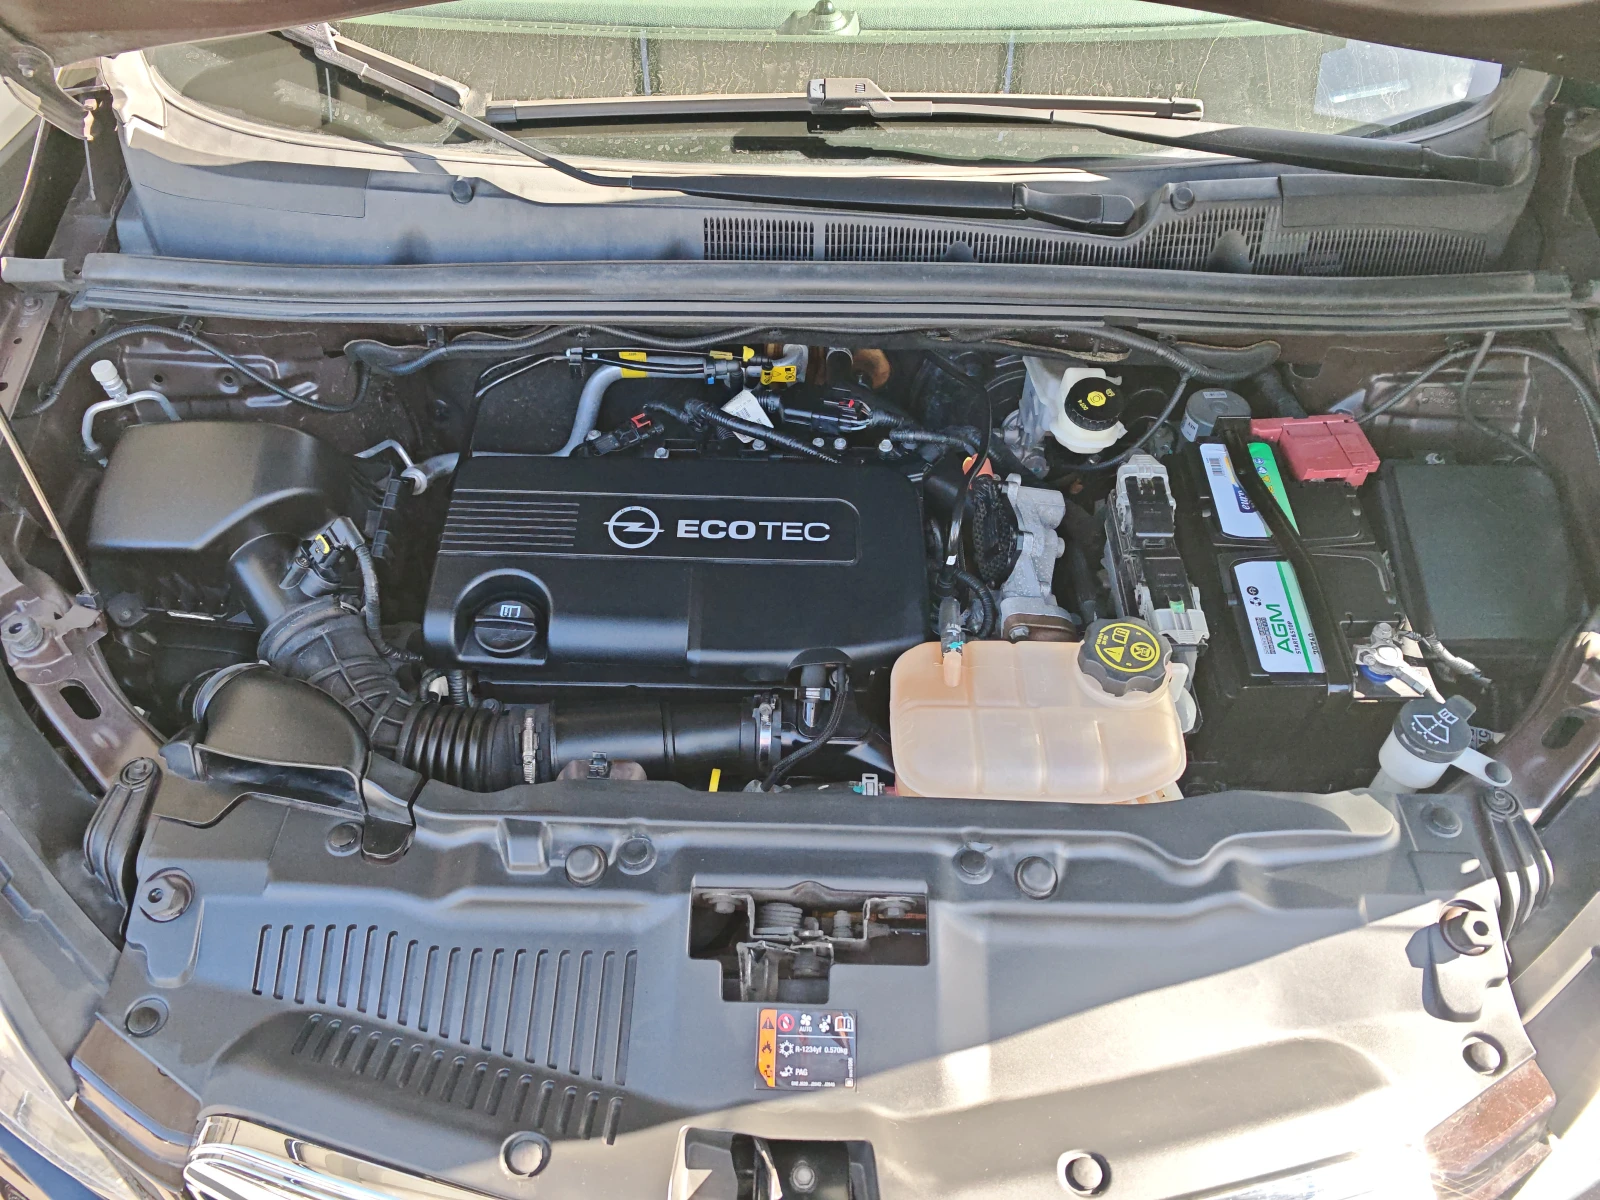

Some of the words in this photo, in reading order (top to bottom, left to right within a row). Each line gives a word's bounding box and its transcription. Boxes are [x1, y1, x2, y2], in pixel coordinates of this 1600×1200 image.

[677, 519, 831, 542] ECOTEC
[1266, 603, 1294, 654] AGM
[795, 1045, 822, 1055] R-1234yf
[824, 1047, 848, 1055] 0.570kg
[795, 1068, 808, 1076] PAG
